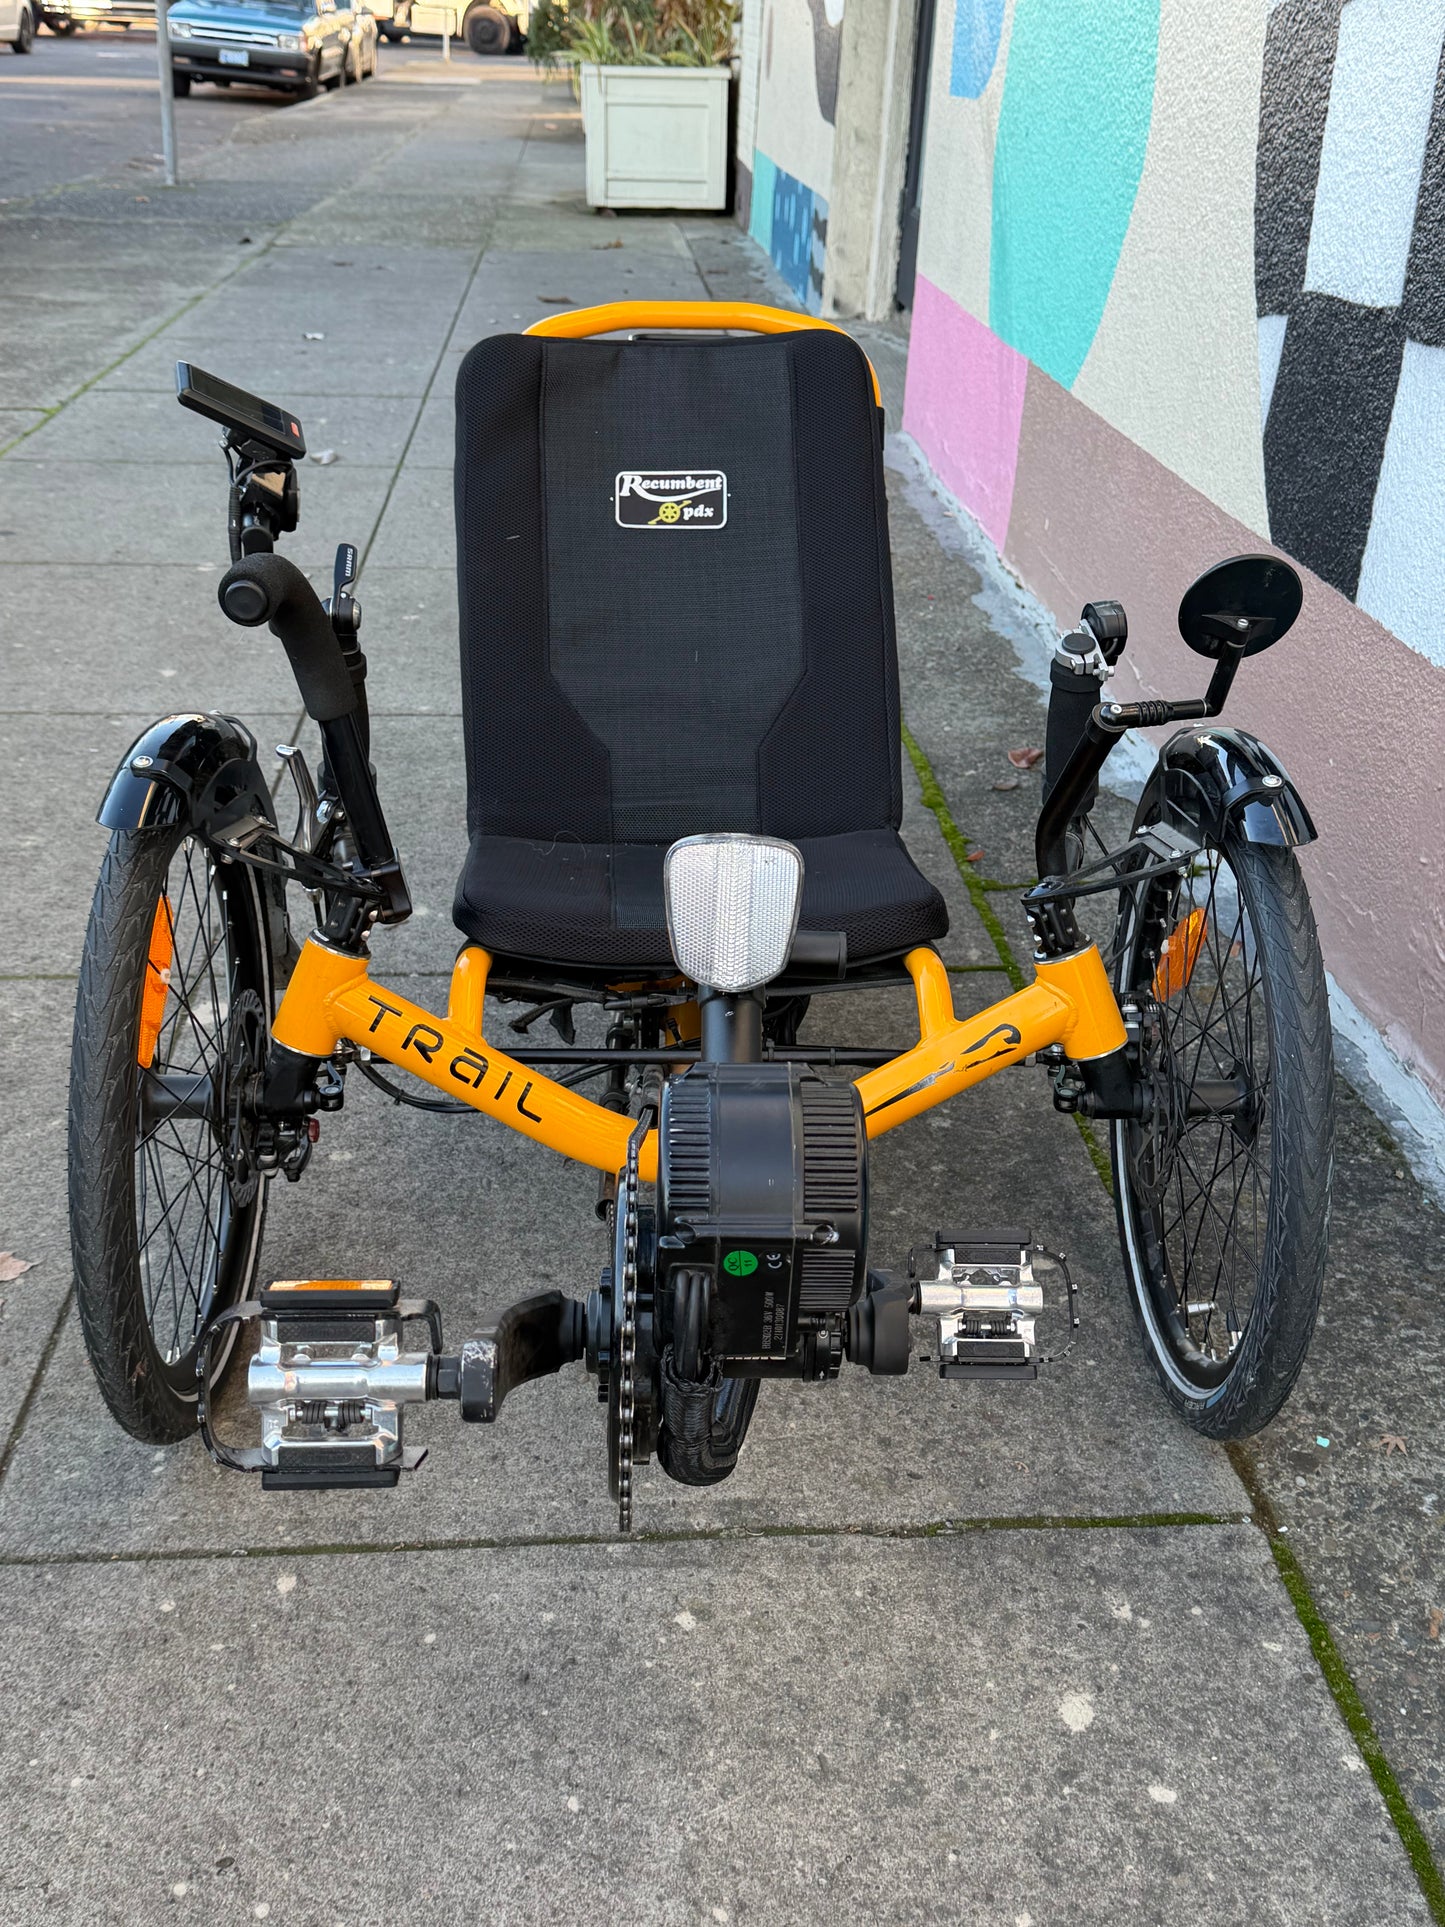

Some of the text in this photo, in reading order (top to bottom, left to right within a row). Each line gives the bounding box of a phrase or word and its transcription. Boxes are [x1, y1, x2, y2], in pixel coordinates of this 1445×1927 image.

[619, 475, 723, 501] Recumbent
[683, 504, 714, 520] pdx
[344, 547, 354, 577] SRAM
[727, 1257, 740, 1272] QC
